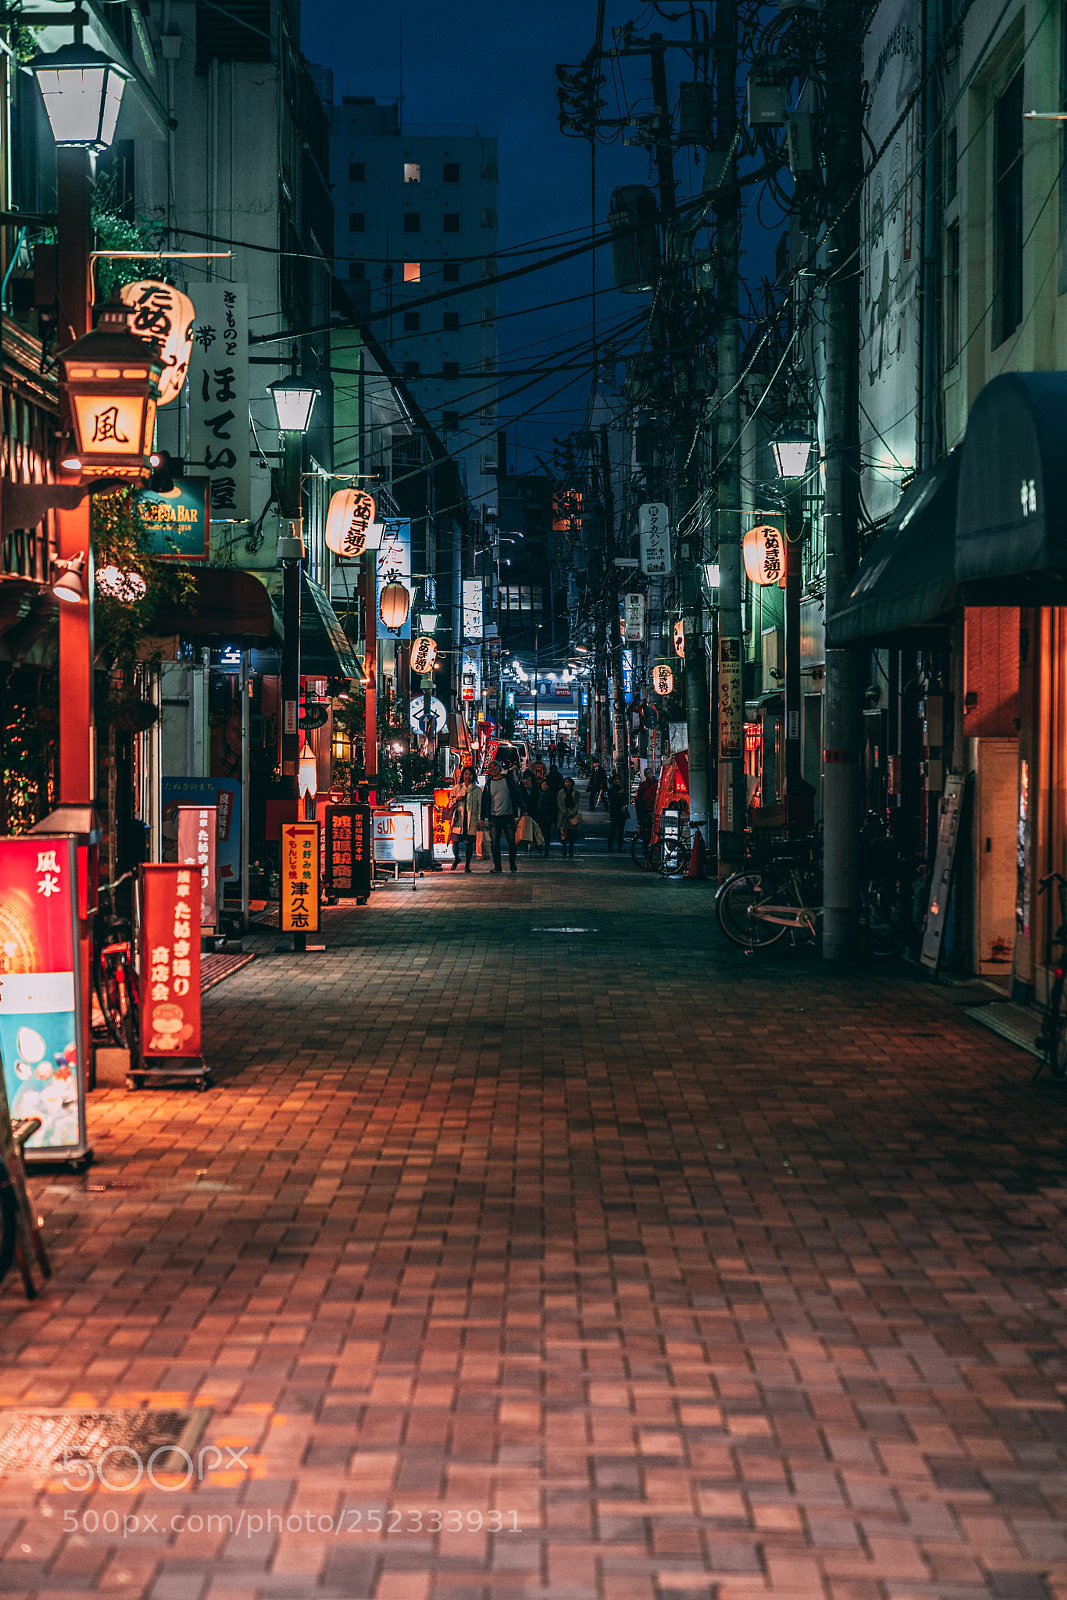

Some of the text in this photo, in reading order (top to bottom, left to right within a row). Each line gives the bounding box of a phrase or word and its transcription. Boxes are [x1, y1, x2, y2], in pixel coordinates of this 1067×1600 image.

[195, 324, 217, 354] 帯
[223, 290, 238, 356] きものと
[92, 406, 129, 443] 風
[202, 367, 237, 510] ほてい屋
[177, 505, 198, 522] BAR
[344, 492, 372, 556] たぬき通り
[649, 516, 661, 548] タカハシ
[761, 528, 781, 581] たぬき通り
[413, 638, 430, 671] たぬき通り
[36, 851, 61, 897] 風水
[288, 840, 298, 879] もんじゃ焼
[302, 840, 312, 879] お好み焼
[290, 881, 309, 928] 津久志
[172, 901, 191, 997] たぬき通り
[151, 946, 170, 1002] 商店会
